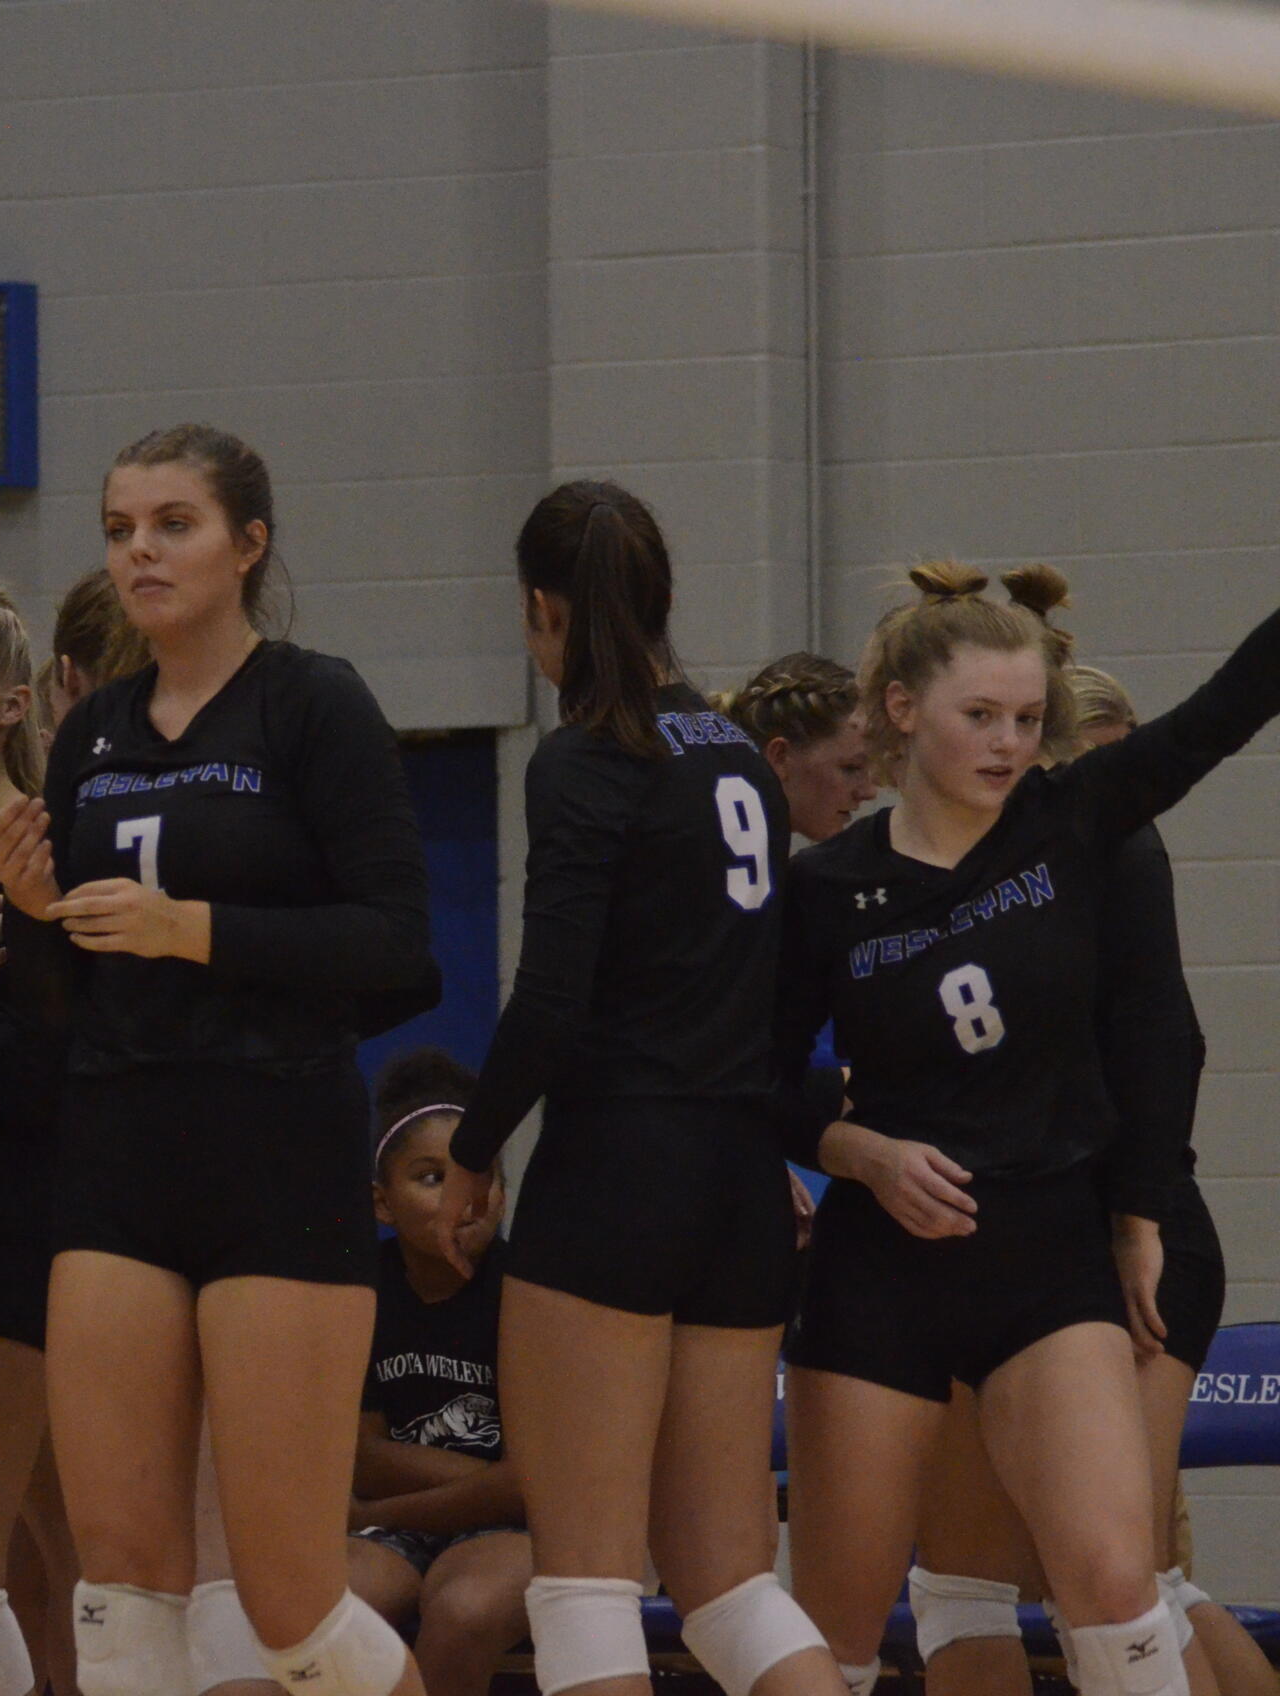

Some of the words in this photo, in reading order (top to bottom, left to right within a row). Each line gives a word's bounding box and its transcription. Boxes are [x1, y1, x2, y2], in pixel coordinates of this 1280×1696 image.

[656, 711, 760, 756] TIGER
[115, 813, 162, 892] 7
[714, 775, 773, 914] 9
[938, 962, 1006, 1055] 8
[1188, 1373, 1280, 1404] ESLE
